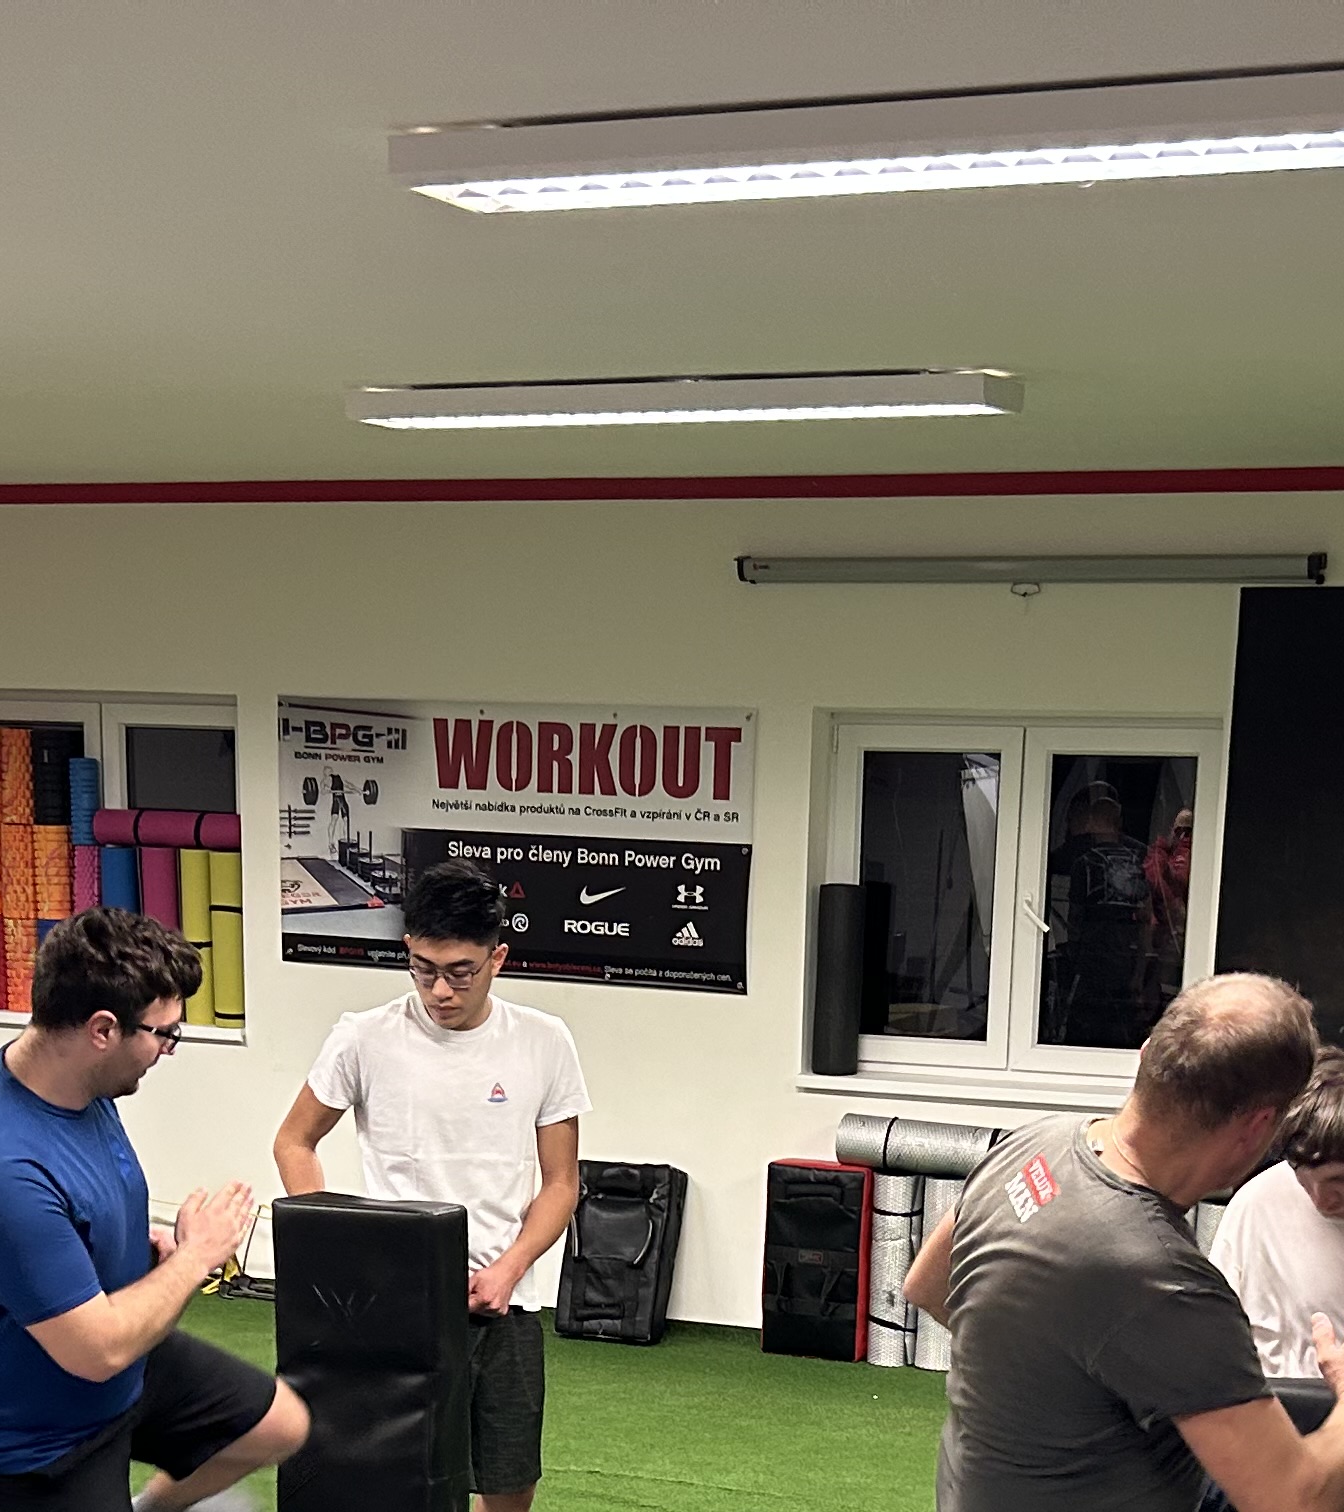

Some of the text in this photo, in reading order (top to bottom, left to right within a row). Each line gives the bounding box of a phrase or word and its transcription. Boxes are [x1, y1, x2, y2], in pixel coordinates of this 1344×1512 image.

[294, 751, 384, 764] BONN POWER GYM
[433, 718, 742, 801] WORKOUT
[475, 801, 516, 813] nabídka
[568, 806, 580, 816] na
[685, 812, 691, 820] v
[694, 808, 710, 822] ČR
[713, 814, 720, 822] a
[723, 812, 739, 822] SR
[448, 841, 721, 875] Sleva pro členy Bonn Power Gym
[564, 919, 630, 937] ROGUE
[672, 937, 704, 947] adidas
[1004, 1171, 1039, 1223] MAN
